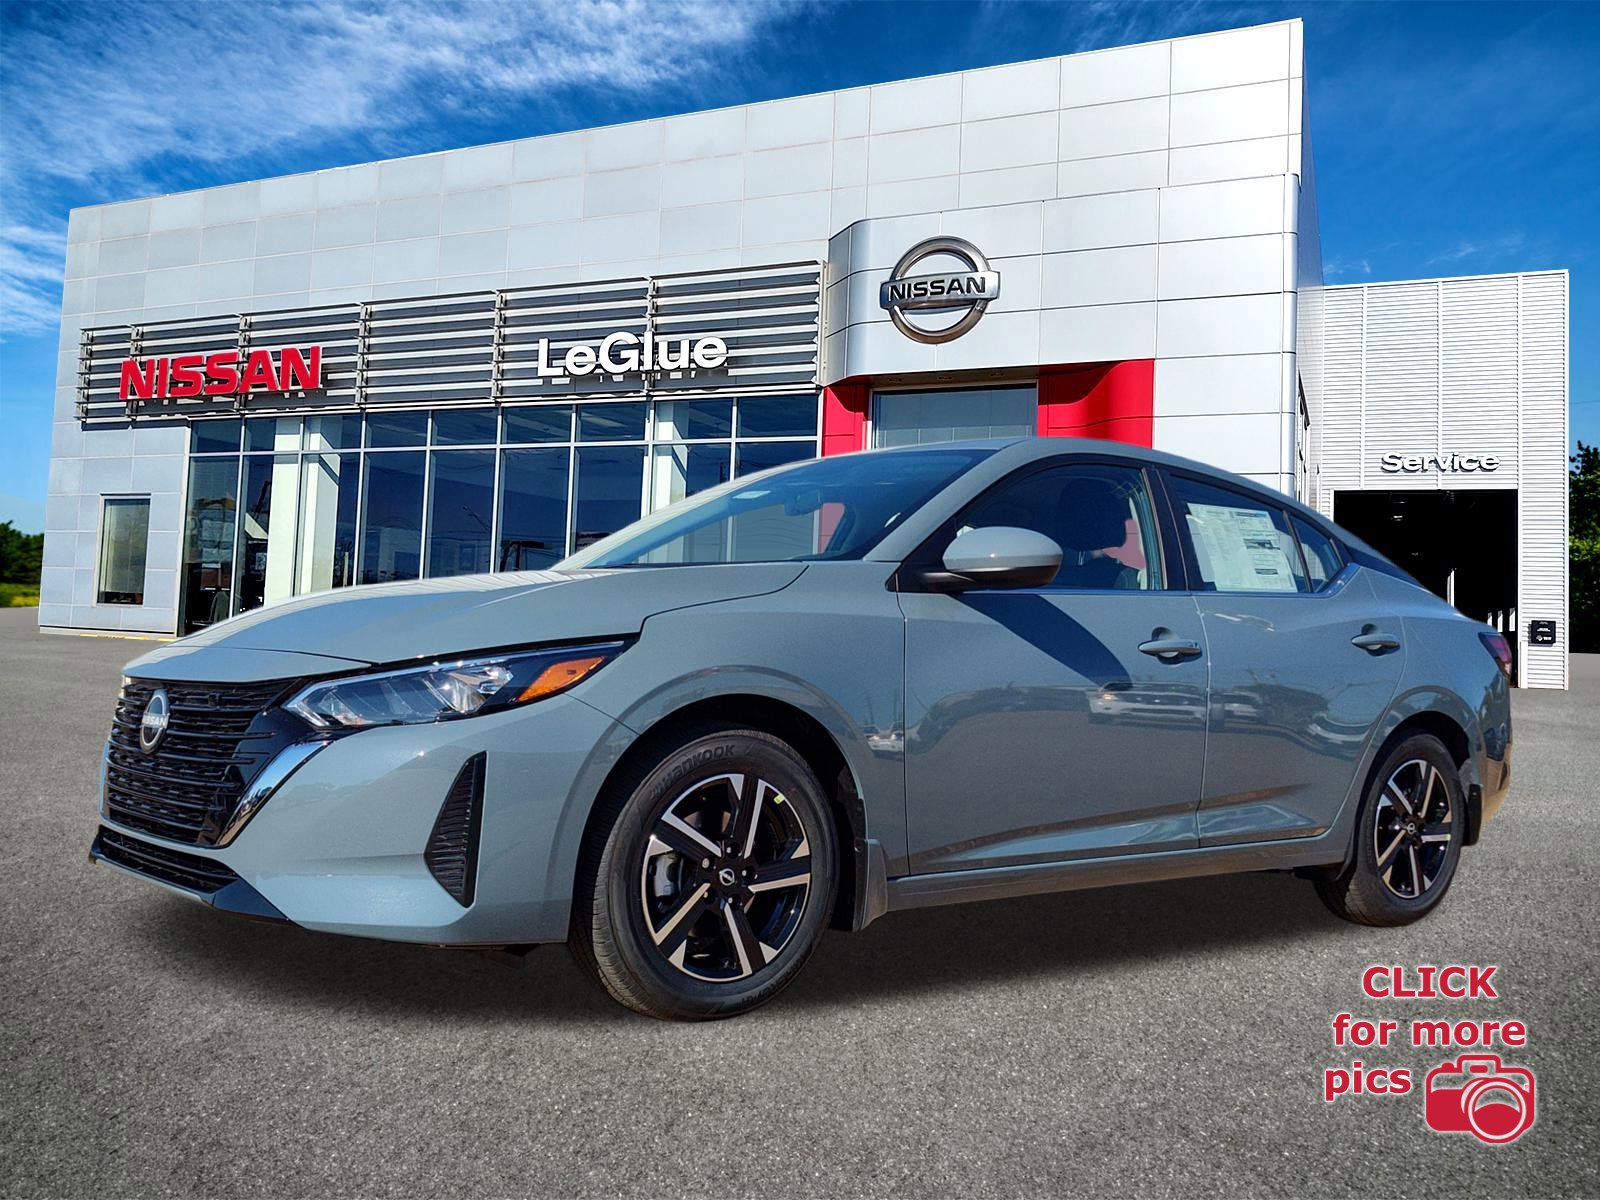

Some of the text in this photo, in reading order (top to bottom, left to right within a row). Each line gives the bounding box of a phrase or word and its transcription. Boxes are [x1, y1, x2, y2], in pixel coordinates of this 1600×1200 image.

[888, 277, 986, 301] NISSAN
[536, 330, 729, 378] LeGlue
[119, 345, 323, 400] NISSAN
[1381, 450, 1500, 473] Service
